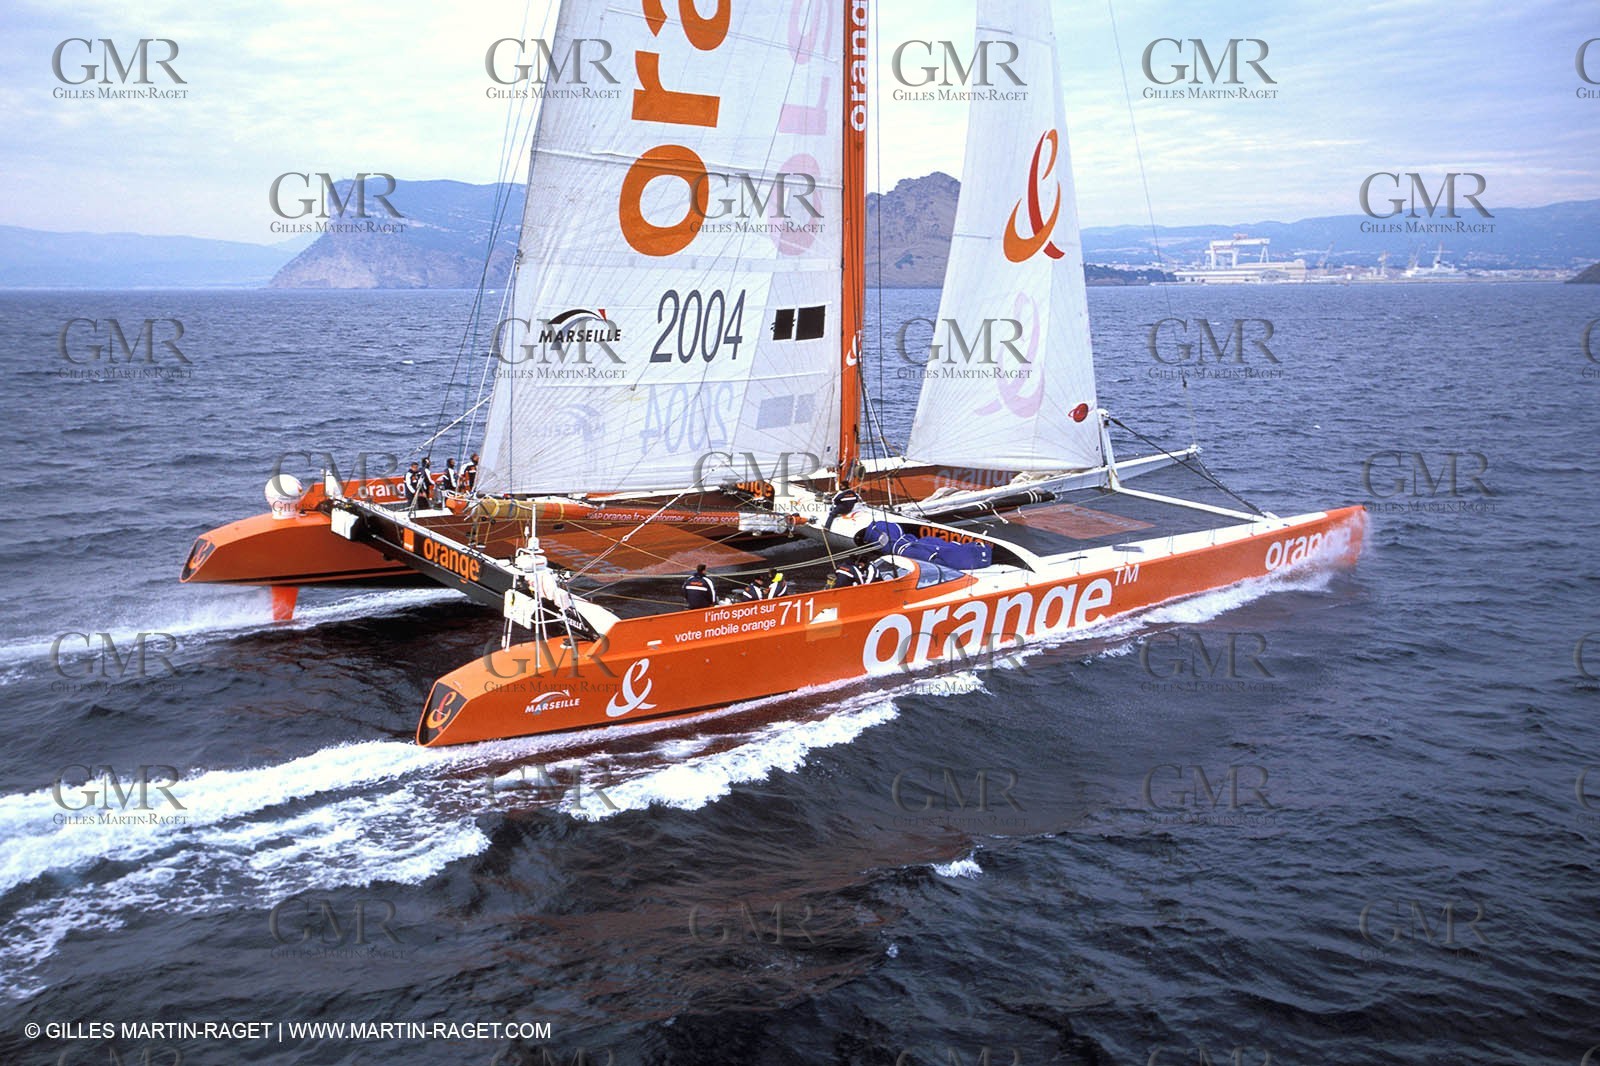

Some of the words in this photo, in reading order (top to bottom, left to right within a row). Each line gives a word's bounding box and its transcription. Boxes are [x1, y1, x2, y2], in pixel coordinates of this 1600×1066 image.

[538, 328, 622, 344] MARSEILLE
[650, 288, 746, 363] 2004
[358, 481, 406, 499] orang
[424, 537, 481, 583] orange
[704, 609, 730, 623] l'info
[731, 604, 758, 621] sport
[760, 602, 776, 614] sur
[778, 597, 815, 626] 711
[674, 629, 702, 643] votre
[704, 622, 739, 638] mobile
[741, 617, 776, 633] orange
[863, 577, 1113, 674] orange
[524, 697, 580, 714] MARSEILLE
